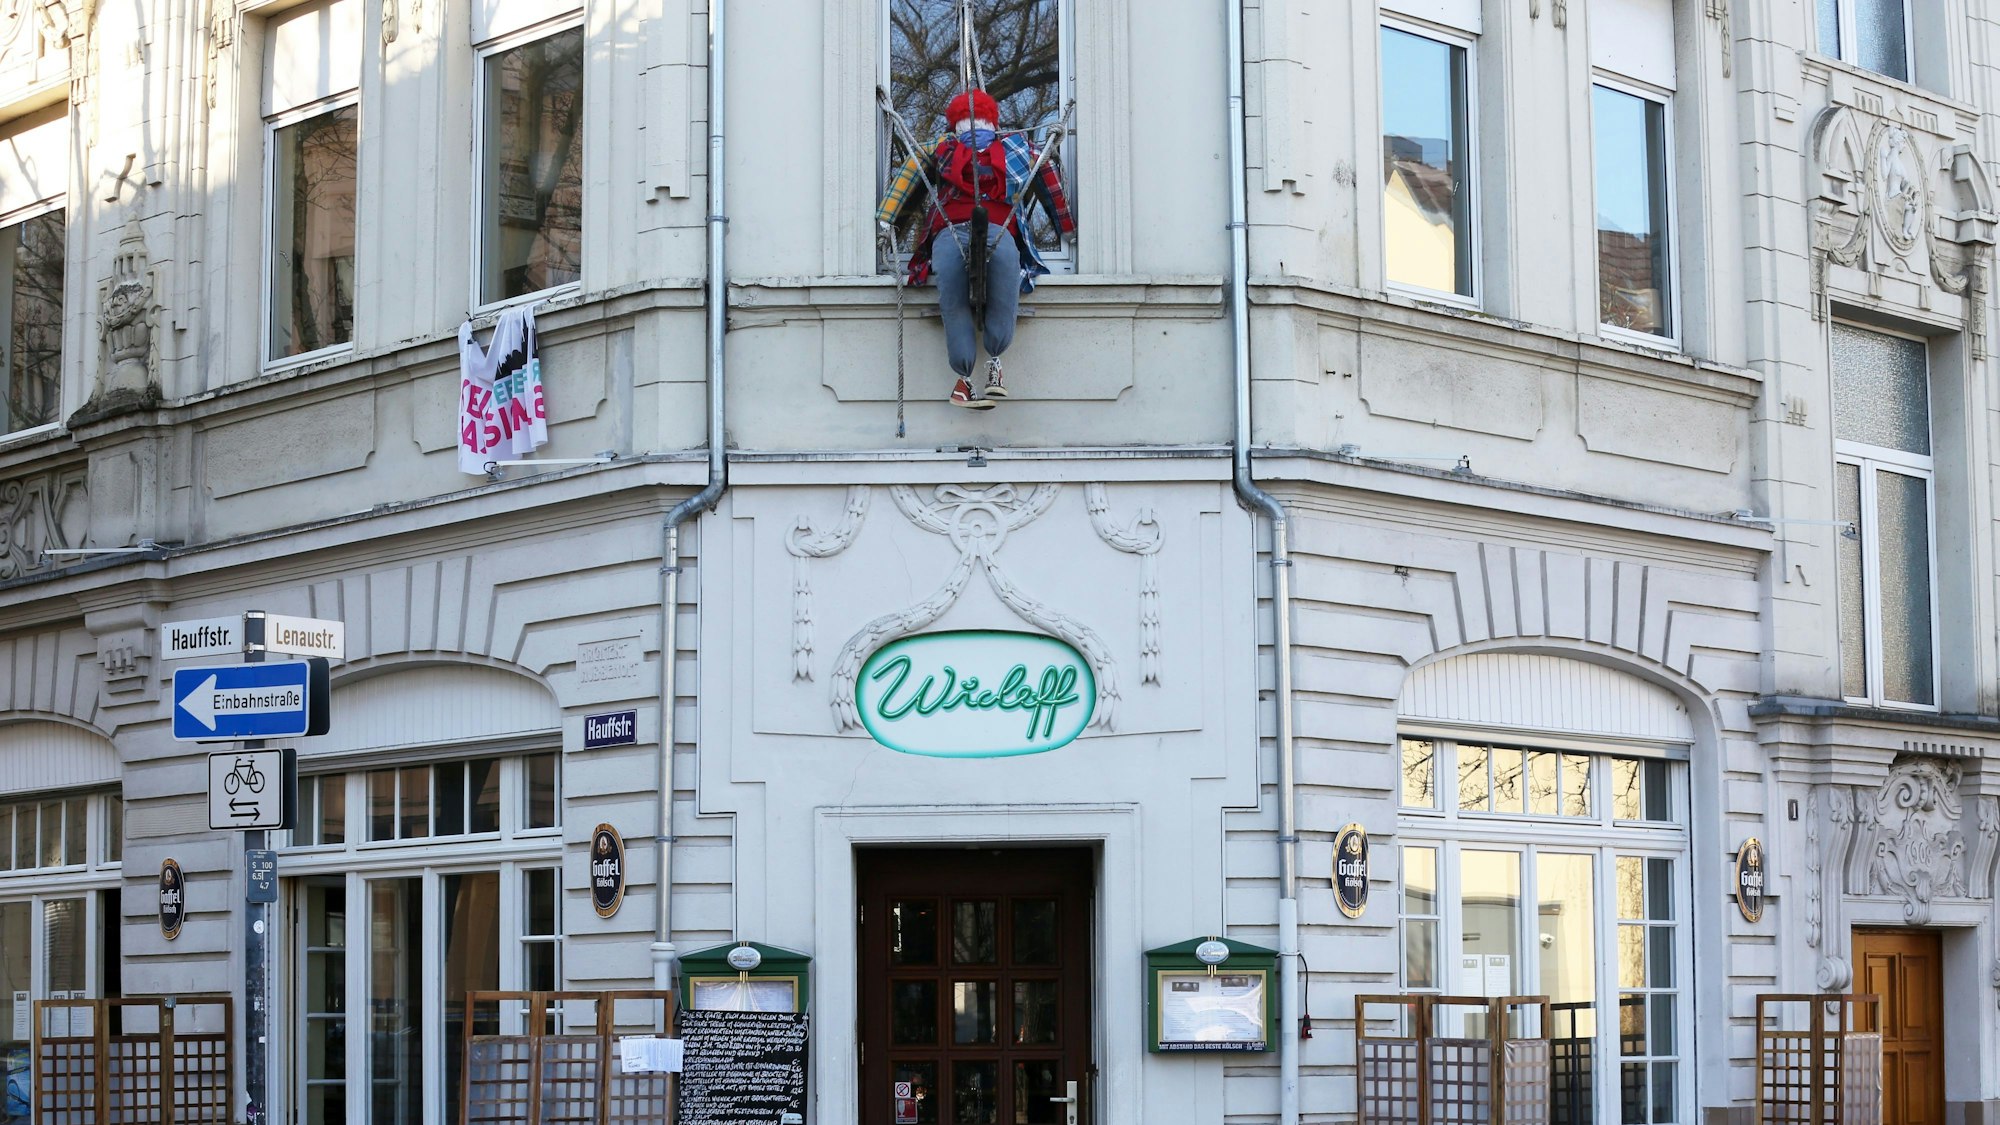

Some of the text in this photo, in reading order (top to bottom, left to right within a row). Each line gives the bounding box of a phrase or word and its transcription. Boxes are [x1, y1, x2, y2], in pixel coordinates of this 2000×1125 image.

[172, 626, 232, 651] Hauffstr.
[276, 622, 336, 650] Lenaustr.
[213, 690, 300, 710] Einbahnstraße
[872, 654, 1079, 739] Wicleff
[587, 715, 632, 741] Hauffstr.
[252, 861, 273, 869] S 100
[592, 859, 620, 877] Gaffel
[1338, 858, 1367, 878] Gaffel
[597, 877, 615, 888] Kölsch
[1741, 870, 1763, 887] Gaffel
[160, 889, 181, 904] Gaffel
[1170, 1042, 1192, 1050] ABSTAND
[1194, 1042, 1204, 1050] DAS
[1205, 1042, 1221, 1050] BESTE
[1222, 1041, 1242, 1049] KÖLSCH
